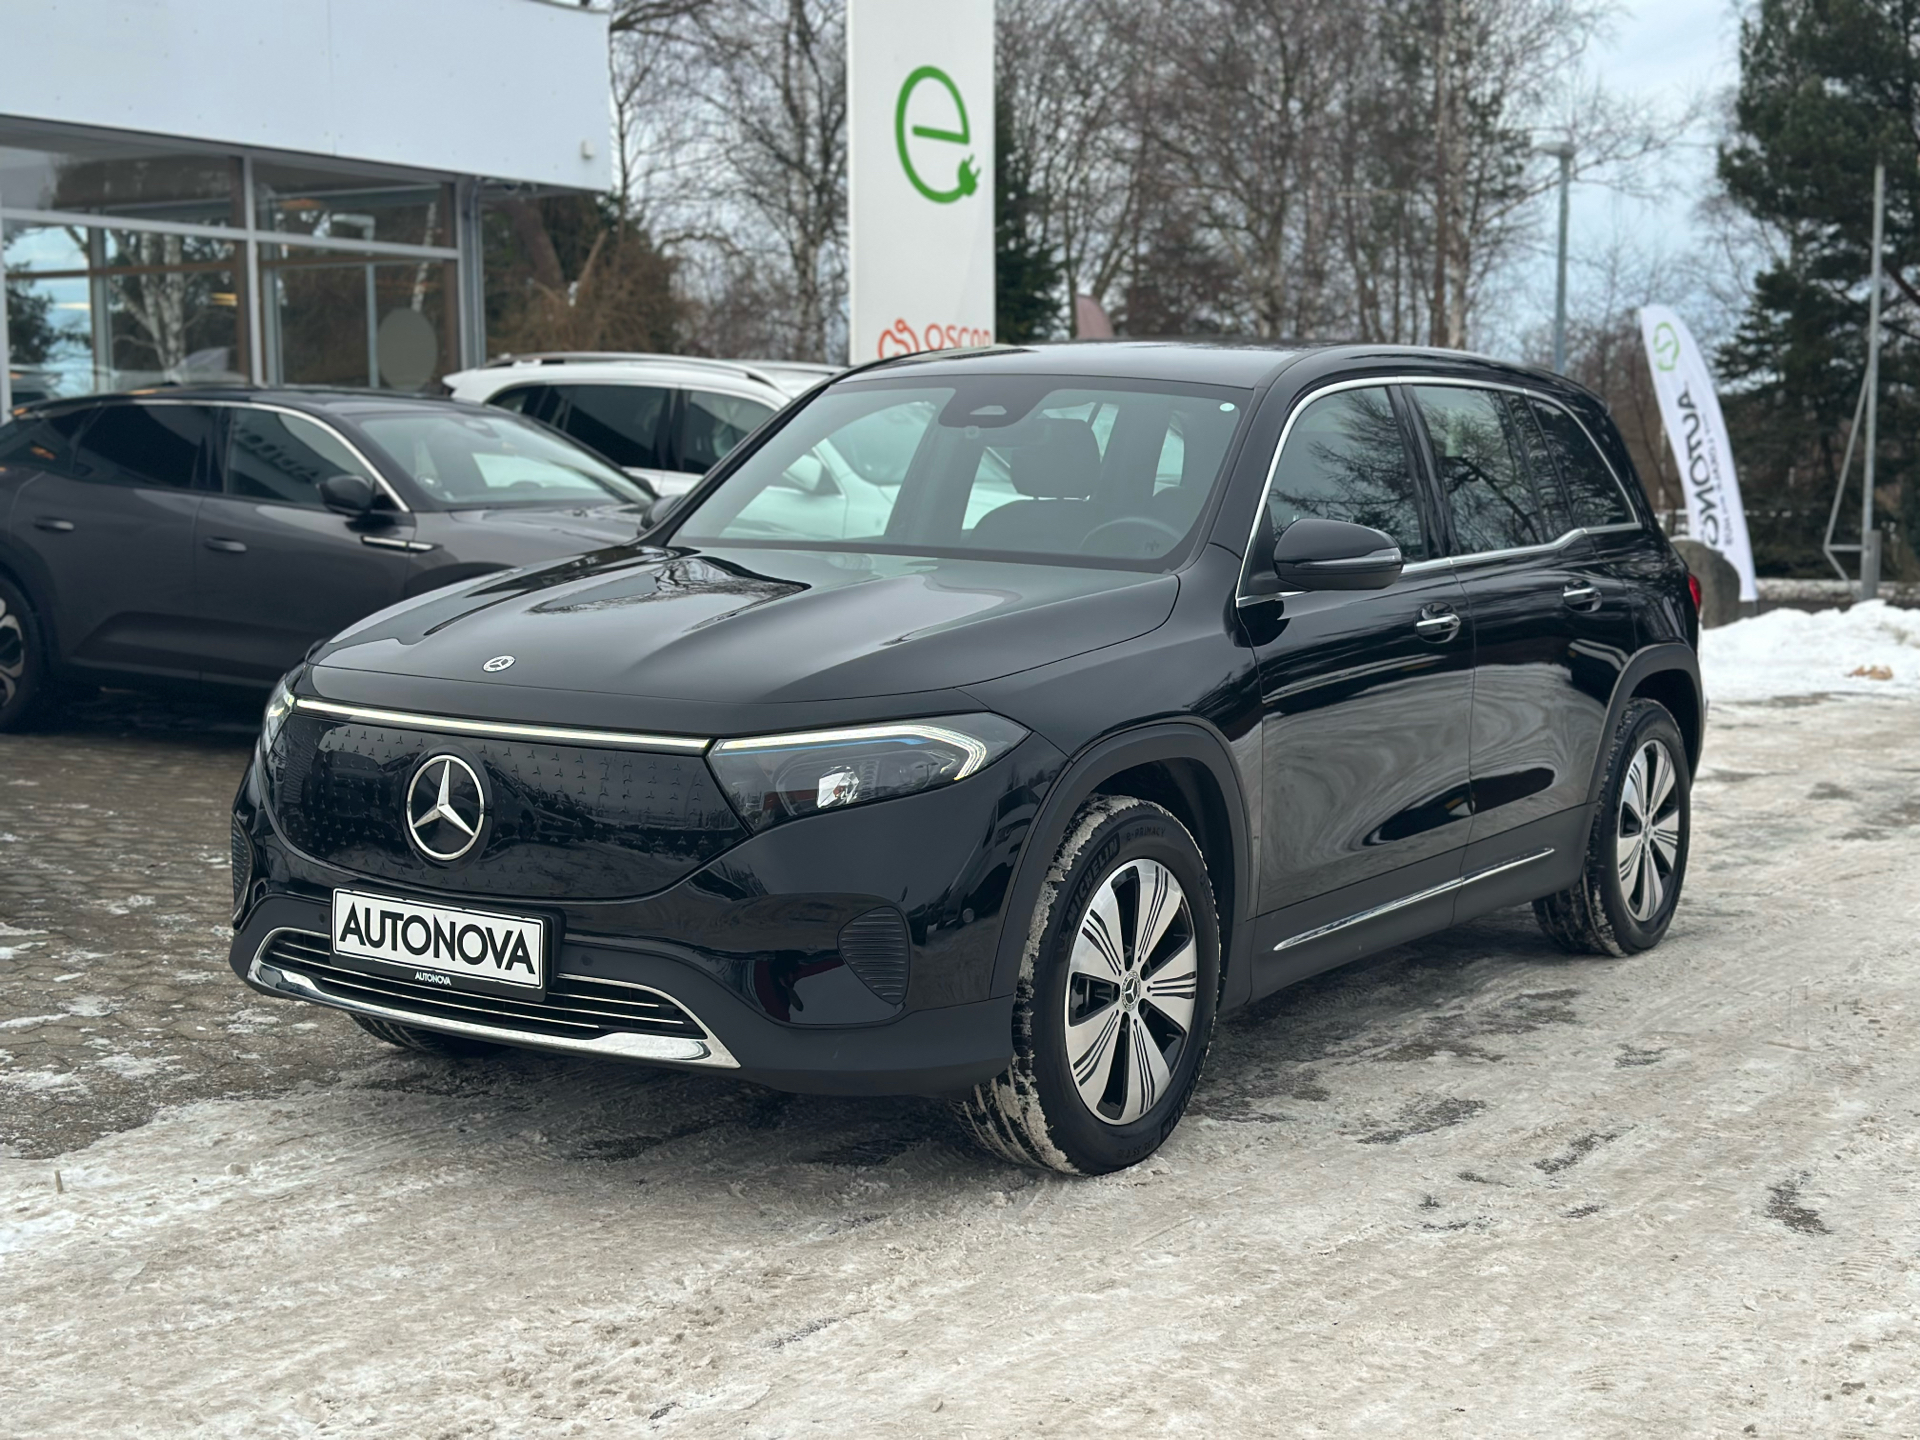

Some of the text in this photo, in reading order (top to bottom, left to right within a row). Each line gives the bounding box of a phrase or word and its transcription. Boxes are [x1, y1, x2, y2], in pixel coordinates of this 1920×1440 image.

[1066, 838, 1119, 925] MICHELIN
[339, 902, 536, 974] AUTONOVA
[414, 971, 452, 986] AUTONOVA
